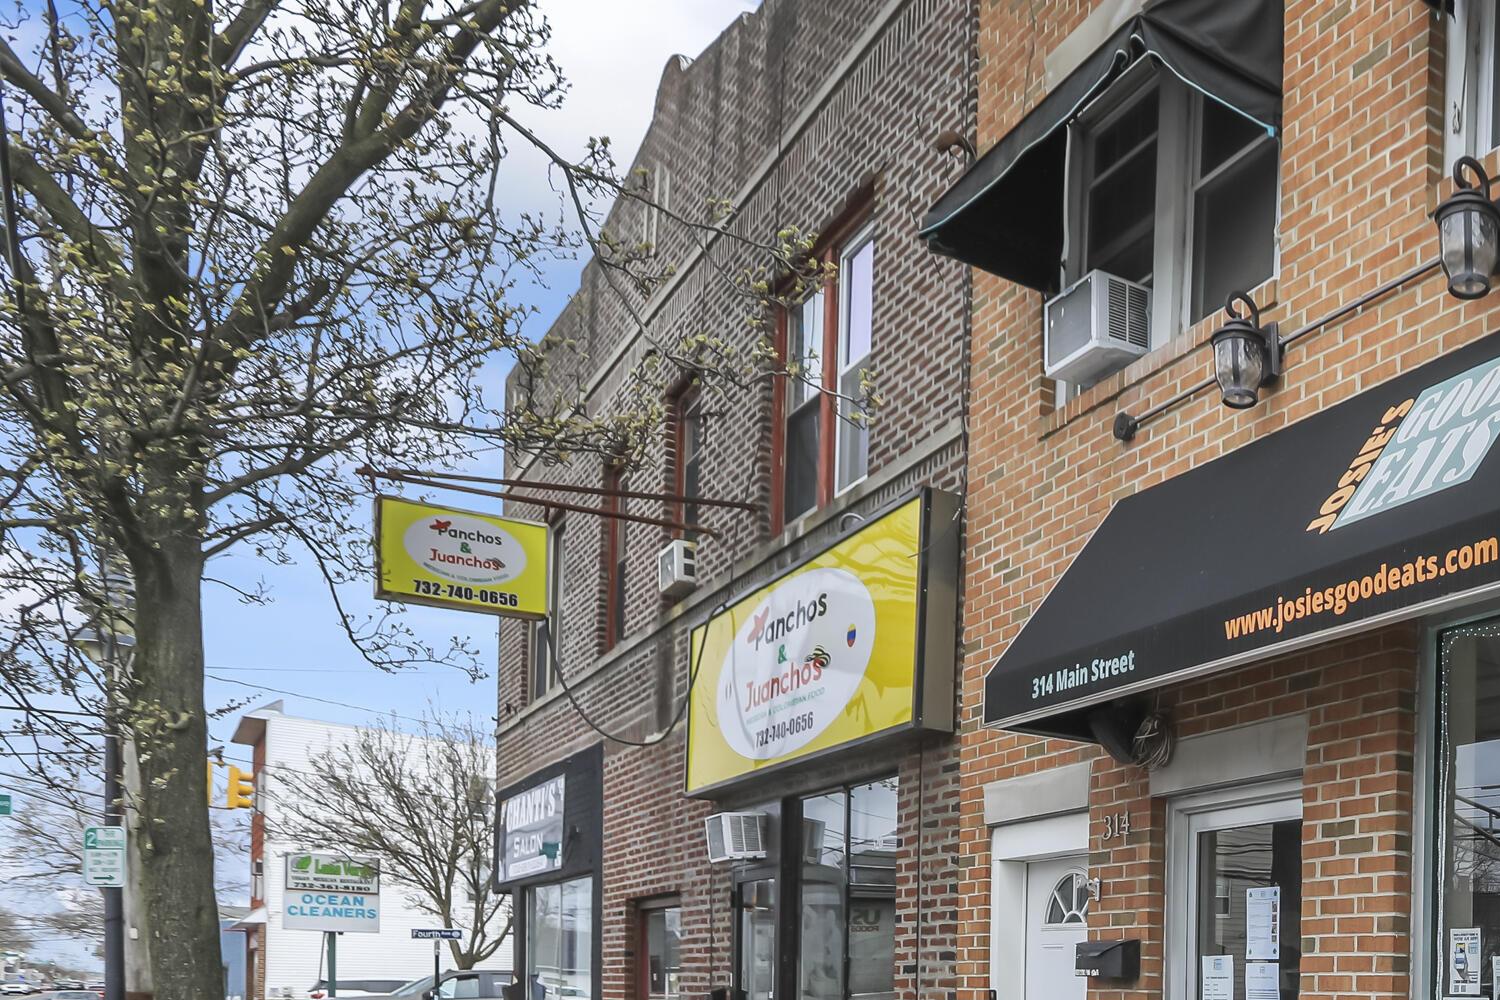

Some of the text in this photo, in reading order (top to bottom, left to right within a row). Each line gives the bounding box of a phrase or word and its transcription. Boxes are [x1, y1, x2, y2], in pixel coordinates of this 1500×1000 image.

[1306, 398, 1415, 534] JOSIE'S
[436, 526, 503, 546] Panchos
[460, 542, 472, 554] &
[429, 547, 501, 572] Juanchos
[413, 579, 519, 608] 732-740-0656
[1224, 536, 1499, 640] www.josiesgoodeats.com
[754, 592, 828, 651] Panchos
[777, 643, 788, 665] &
[745, 656, 824, 713] Juanchos
[1031, 649, 1136, 699] 314 Main Street
[754, 710, 815, 750] 732-740-0656
[86, 831, 97, 847] 2
[1102, 810, 1130, 840] 314
[513, 831, 544, 859] SALON
[287, 904, 377, 920] CLEANERS
[301, 893, 365, 907] OCEAN
[411, 929, 441, 939] Fourth
